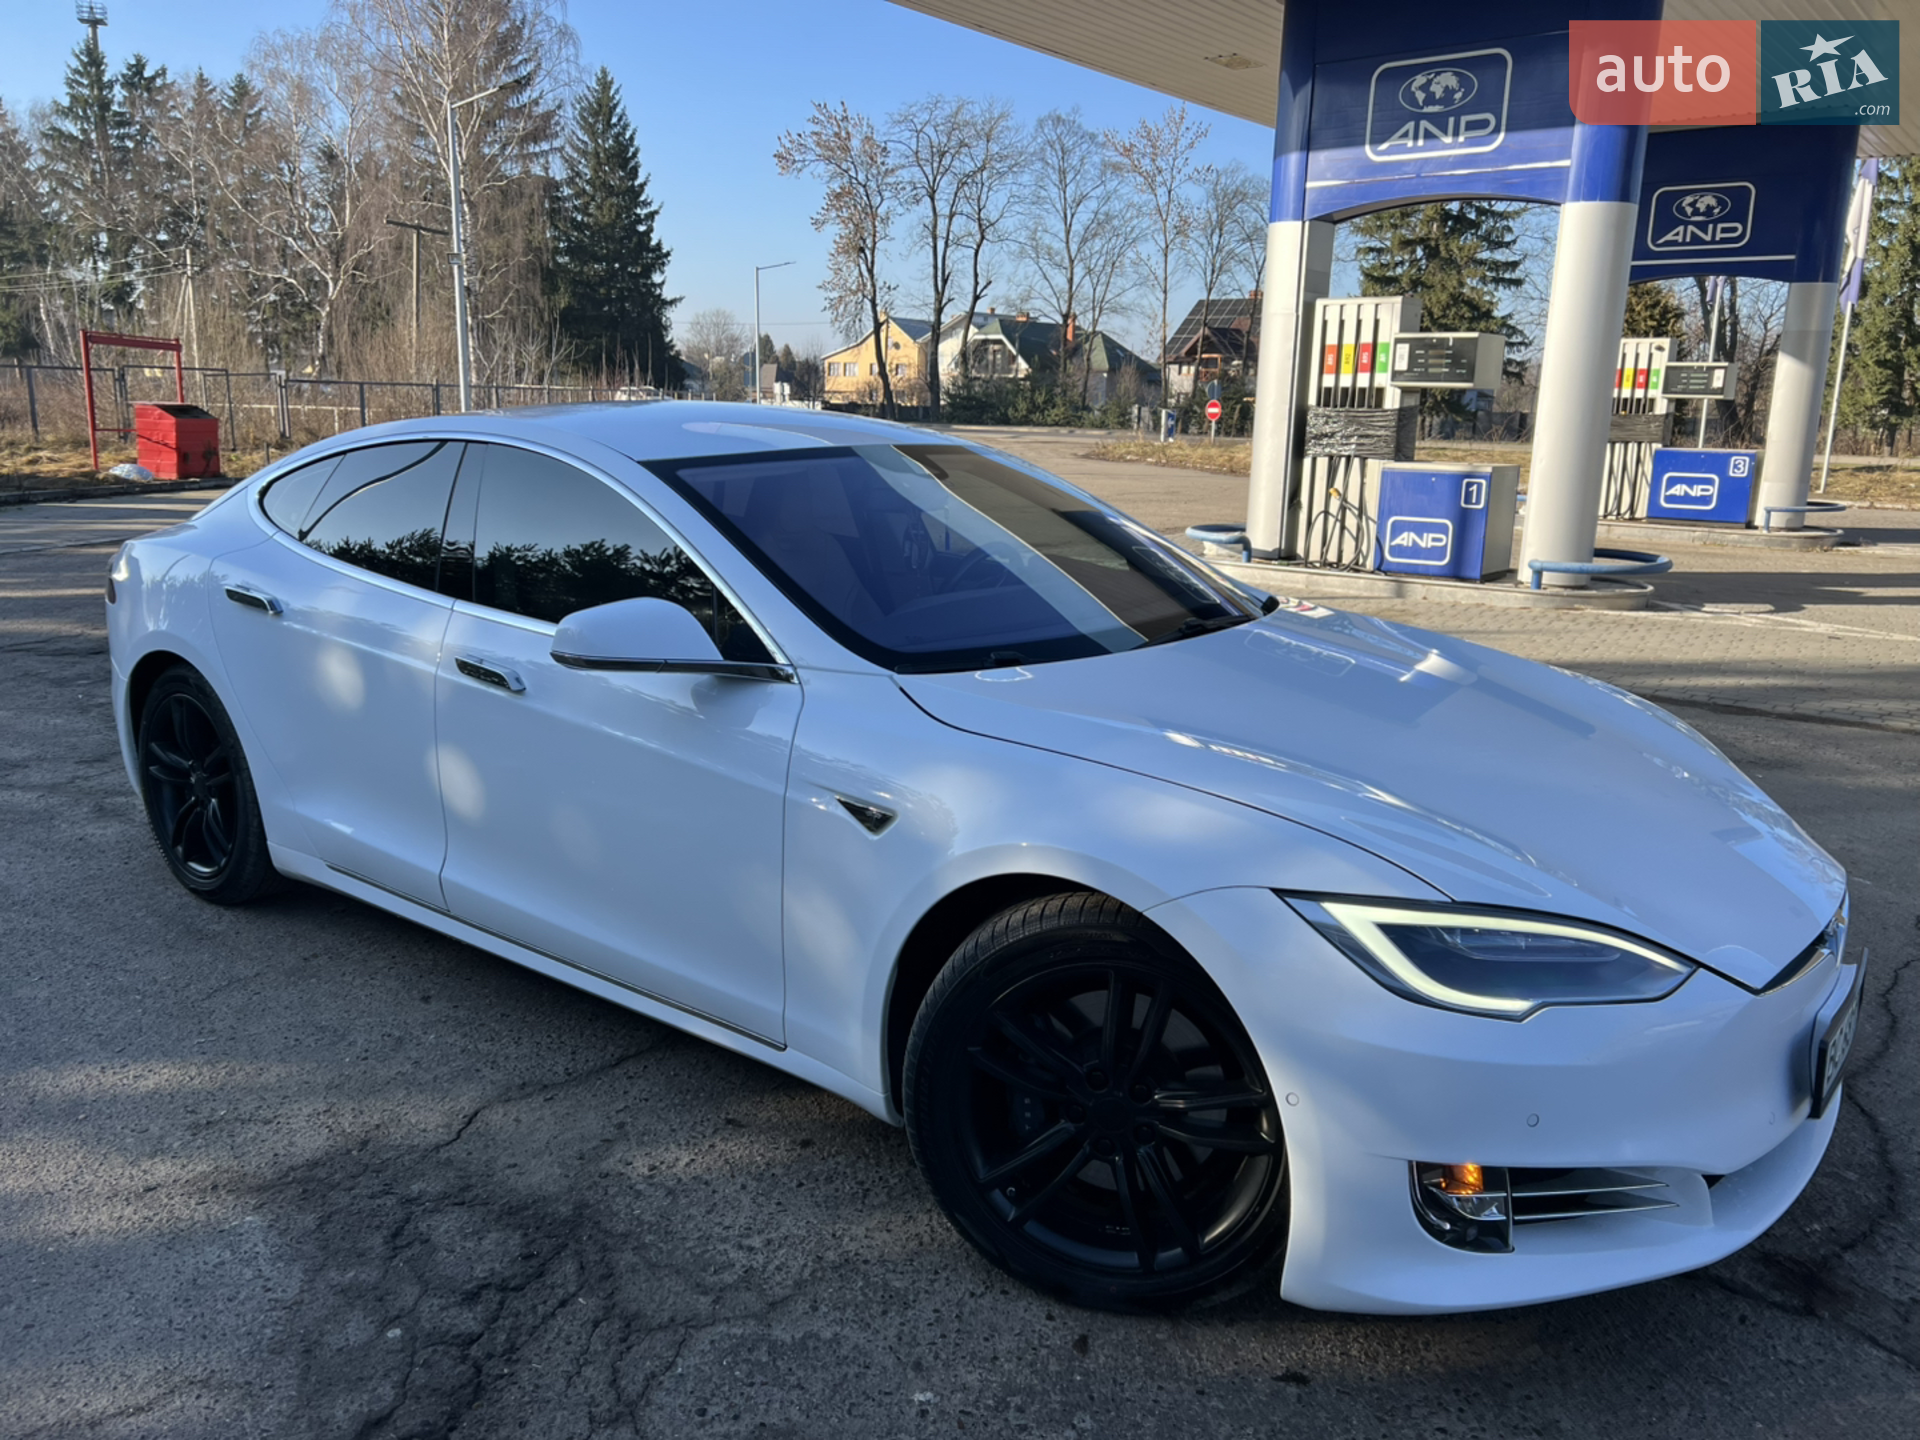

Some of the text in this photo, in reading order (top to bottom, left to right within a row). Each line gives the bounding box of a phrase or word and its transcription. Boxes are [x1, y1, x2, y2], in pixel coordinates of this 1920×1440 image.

[1376, 112, 1497, 151] ANP
[1655, 222, 1743, 245] ANP
[1733, 459, 1745, 474] 3
[1468, 483, 1478, 504] 1
[1665, 483, 1714, 497] ANP
[1390, 531, 1447, 548] ANP
